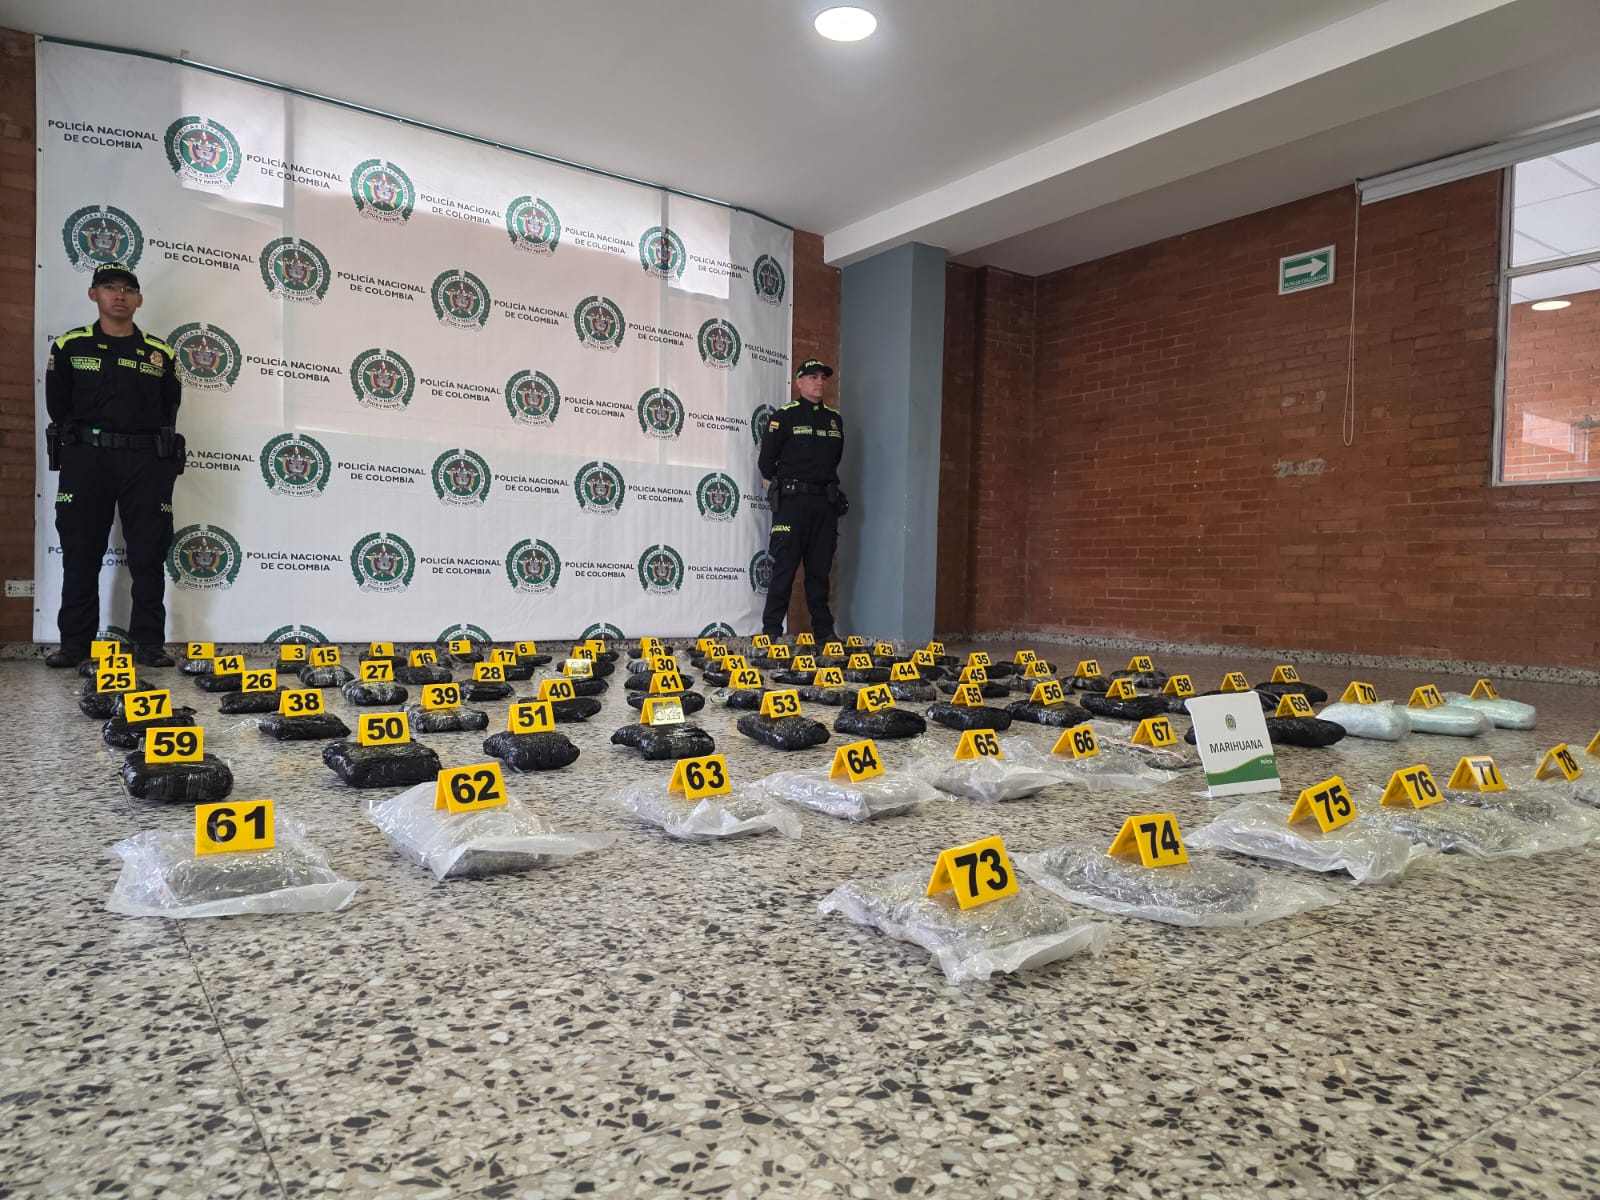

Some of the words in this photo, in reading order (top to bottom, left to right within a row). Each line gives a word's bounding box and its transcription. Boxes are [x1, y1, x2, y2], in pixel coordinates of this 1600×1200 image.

[48, 120, 94, 132] POLICÍA
[98, 126, 158, 141] NACIONAL
[64, 134, 78, 142] DE
[82, 136, 142, 150] COLOMBIA
[247, 154, 288, 169] POLICÍA
[291, 163, 342, 182] NACIONAL
[261, 167, 274, 176] DE
[277, 171, 330, 189] COLOMBIA
[421, 194, 455, 207] POLICÍA
[458, 202, 501, 218] NACIONAL
[432, 206, 443, 214] DE
[446, 210, 490, 225] COLOMBIA
[566, 227, 595, 239] POLICÍA
[597, 234, 634, 247] NACIONAL
[150, 239, 194, 252] POLICÍA
[197, 246, 254, 263] NACIONAL
[165, 252, 178, 260] DE
[182, 255, 240, 271] COLOMBIA
[717, 260, 749, 273] NACIONAL
[338, 272, 375, 284] POLICÍA
[378, 279, 426, 293] NACIONAL
[350, 284, 362, 292] DE
[365, 287, 413, 301] COLOMBIA
[494, 300, 526, 312] POLICÍA
[528, 306, 569, 318] NACIONAL
[518, 313, 559, 325] COLOMBIA
[629, 323, 656, 334] POLICÍA
[658, 328, 693, 339] NACIONAL
[649, 335, 684, 346] COLOMBIA
[247, 356, 288, 367] POLICÍA
[291, 361, 342, 374] NACIONAL
[277, 370, 330, 382] COLOMBIA
[420, 378, 455, 389] POLICÍA
[457, 383, 501, 394] NACIONAL
[445, 391, 490, 402] COLOMBIA
[565, 397, 594, 406] POLICÍA
[596, 401, 634, 410] NACIONAL
[586, 408, 625, 418] COLOMBIA
[689, 413, 714, 421] POLICÍA
[716, 416, 748, 425] NACIONAL
[706, 423, 739, 432] COLOMBIA
[198, 451, 254, 462] NACIONAL
[338, 462, 376, 471] POLICÍA
[378, 466, 426, 475] NACIONAL
[366, 474, 414, 483] COLOMBIA
[495, 474, 526, 483] POLICÍA
[529, 477, 569, 486] NACIONAL
[518, 485, 559, 494] COLOMBIA
[629, 485, 656, 493] POLICÍA
[649, 495, 683, 503] COLOMBIA
[247, 552, 288, 560] POLICÍA
[277, 563, 330, 571] COLOMBIA
[452, 642, 459, 651] 5
[520, 644, 527, 653] 6
[596, 643, 602, 651] 7
[758, 638, 768, 646] 10
[108, 644, 115, 654] 1
[192, 645, 202, 655] 2
[295, 648, 303, 658] 3
[375, 645, 383, 654] 4
[579, 650, 592, 660] 18
[649, 648, 662, 656] 19
[713, 647, 725, 656] 20
[775, 648, 786, 657] 21
[830, 645, 841, 654] 22
[882, 645, 893, 655] 23
[934, 645, 943, 654] 24
[105, 656, 128, 668] 13
[318, 650, 336, 662] 15
[417, 653, 434, 665] 16
[498, 651, 513, 662] 17
[855, 656, 869, 667] 33
[919, 652, 931, 663] 34
[975, 655, 988, 664] 35
[1022, 653, 1034, 662] 36
[219, 658, 239, 670] 14
[658, 659, 674, 671] 30
[730, 658, 744, 669] 31
[800, 658, 814, 668] 32
[1035, 663, 1047, 673] 46
[1087, 662, 1097, 674] 47
[1139, 659, 1151, 670] 48
[366, 664, 388, 679] 27
[480, 667, 501, 679] 28
[900, 664, 915, 676] 44
[971, 669, 984, 681] 45
[1283, 666, 1297, 679] 60
[102, 673, 130, 690] 25
[246, 674, 272, 689] 26
[661, 675, 679, 689] 41
[738, 671, 758, 684] 42
[825, 672, 841, 684] 43
[1232, 674, 1247, 687] 59
[550, 683, 571, 698] 40
[1121, 680, 1136, 695] 57
[1176, 678, 1191, 692] 58
[432, 687, 458, 705] 39
[867, 688, 890, 706] 54
[966, 688, 981, 703] 55
[1044, 684, 1061, 700] 56
[1359, 685, 1376, 702] 70
[1422, 688, 1442, 704] 71
[133, 694, 166, 716] 37
[288, 693, 319, 711] 38
[773, 695, 797, 713] 53
[1291, 695, 1310, 712] 69
[519, 706, 547, 727] 51
[368, 718, 403, 740] 50
[1152, 722, 1170, 741] 67
[154, 732, 197, 756] 59
[974, 734, 999, 756] 65
[1074, 730, 1094, 753] 66
[1210, 740, 1264, 753] MARIHUANA
[848, 746, 876, 774] 64
[1557, 750, 1578, 774] 78
[686, 761, 724, 790] 63
[1472, 760, 1498, 785] 77
[451, 770, 499, 804] 62
[1405, 770, 1438, 800] 76
[1313, 785, 1351, 823] 75
[207, 806, 265, 842] 61
[1140, 820, 1180, 858] 74
[954, 849, 1008, 897] 73
